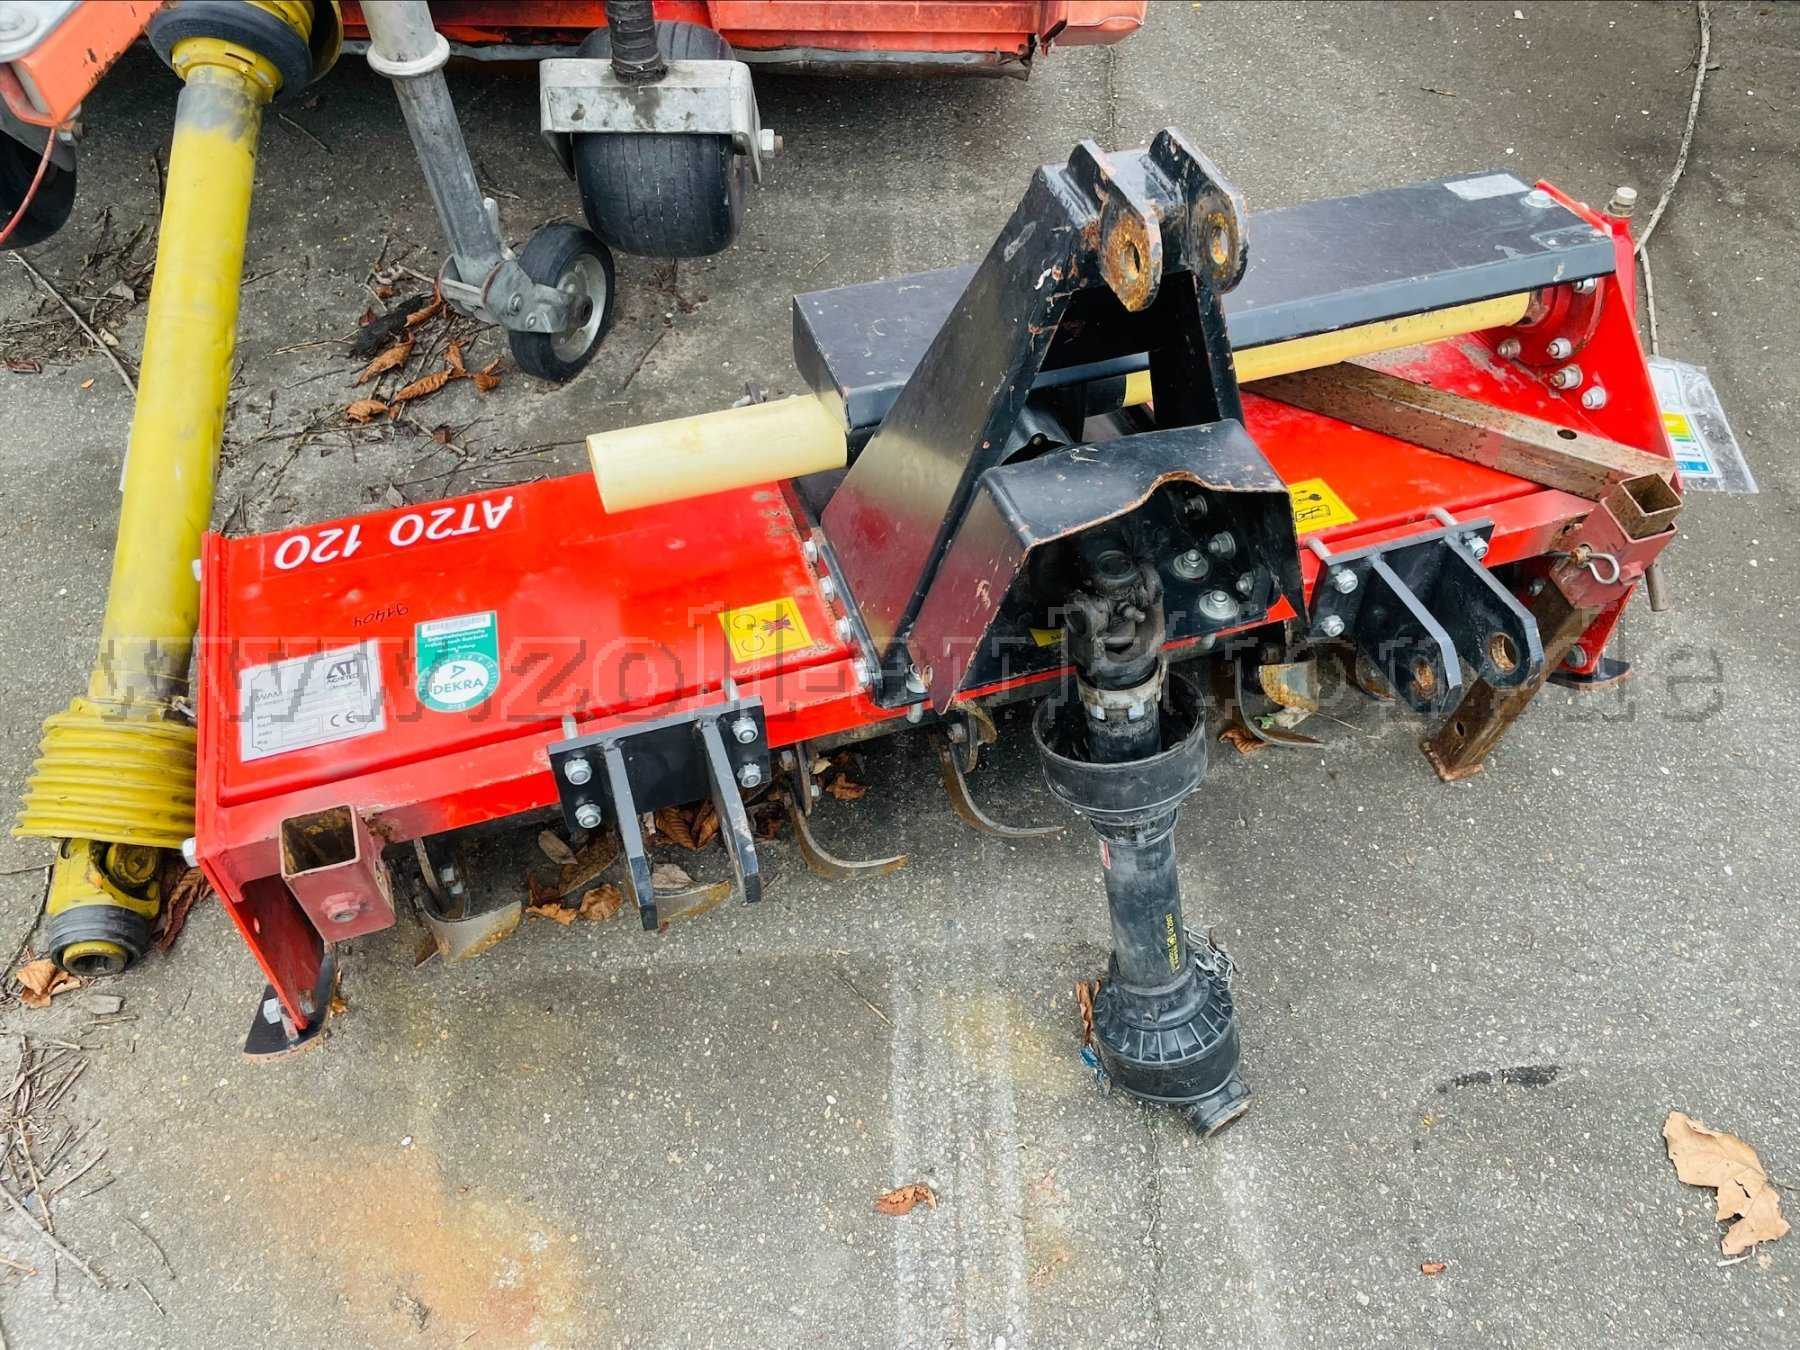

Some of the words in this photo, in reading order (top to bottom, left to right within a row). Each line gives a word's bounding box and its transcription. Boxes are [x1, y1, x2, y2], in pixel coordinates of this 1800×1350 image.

[389, 495, 514, 547] AT20
[273, 523, 363, 571] 120
[432, 677, 484, 695] DEKRA
